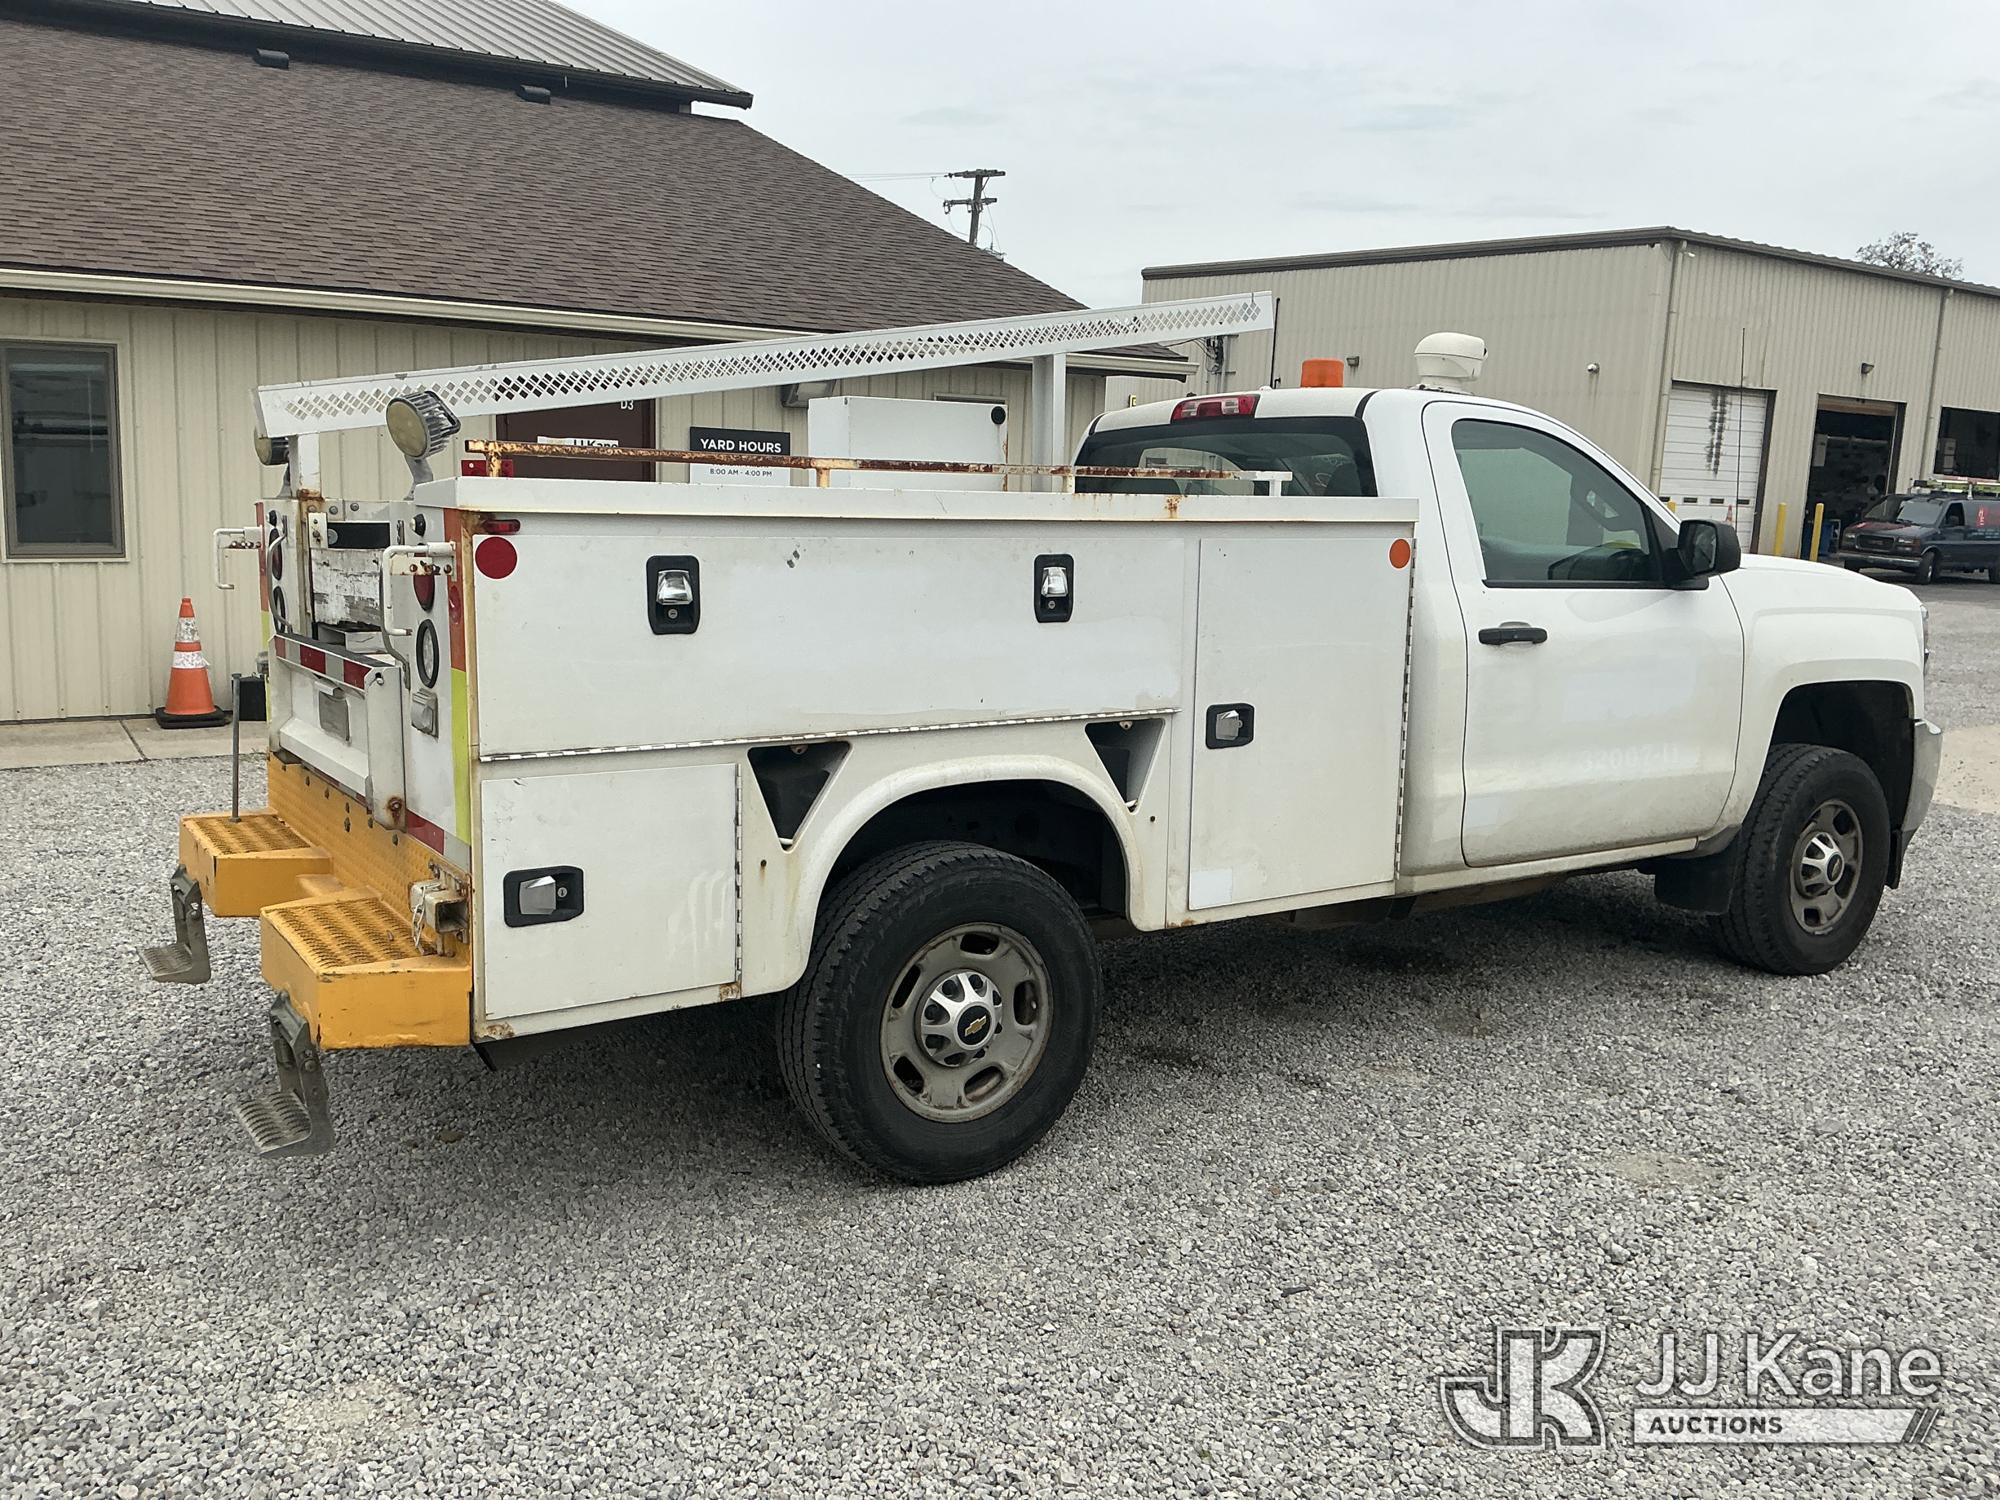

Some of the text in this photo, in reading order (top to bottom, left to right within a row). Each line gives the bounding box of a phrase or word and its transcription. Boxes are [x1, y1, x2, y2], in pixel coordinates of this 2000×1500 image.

[620, 399, 634, 410] D3
[700, 438, 782, 453] YARD HOURS
